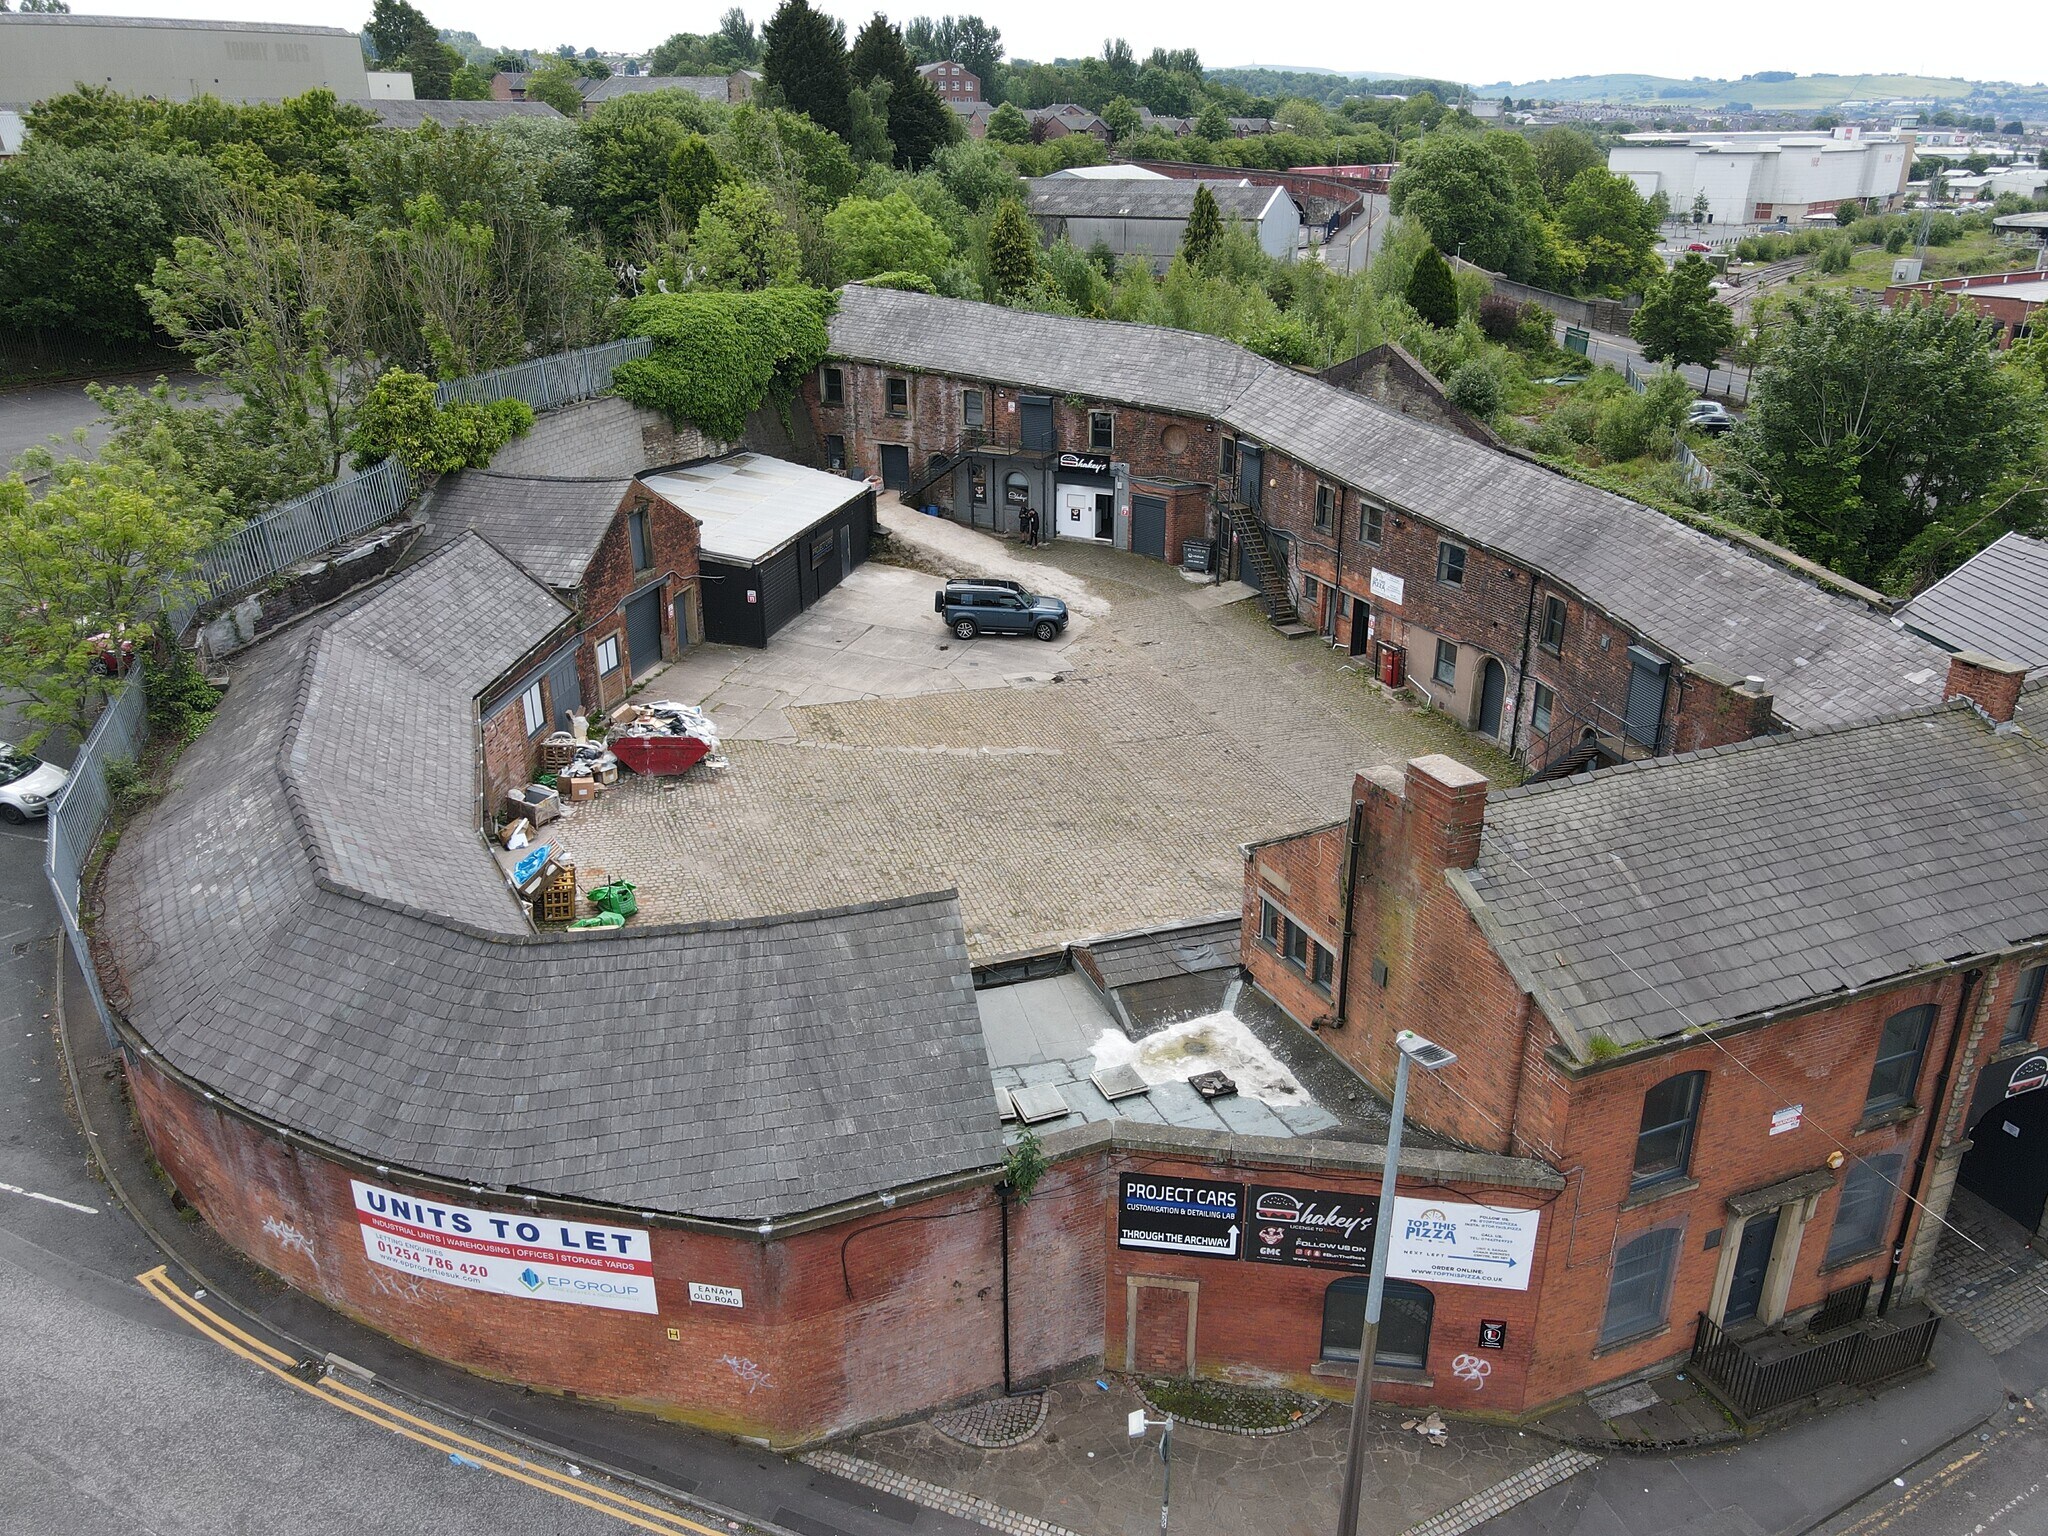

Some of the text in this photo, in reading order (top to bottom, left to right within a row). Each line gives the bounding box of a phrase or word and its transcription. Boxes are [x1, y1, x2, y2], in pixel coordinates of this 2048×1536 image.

[224, 41, 268, 61] TOMMY
[1060, 454, 1107, 473] Shakey's
[1127, 1183, 1236, 1207] PROJECT CARS
[1126, 1203, 1179, 1214] CUSTOMISATION
[1187, 1209, 1221, 1219] DETAILING
[1222, 1212, 1235, 1220] LAB
[1256, 1192, 1372, 1239] Shakey's
[366, 1190, 632, 1254] UNITS TO LET
[1408, 1219, 1457, 1231] TOP THIS
[372, 1217, 635, 1271] INDUSTRIAL UNITS WAREHOUSING OFFICES STORAGE YARDS
[375, 1232, 444, 1257] LETTING ENQUIRIES
[1122, 1229, 1229, 1247] THROUGH THE ARCHWAY
[1295, 1240, 1337, 1249] FOLLOW
[1405, 1226, 1457, 1245] PIZZA
[377, 1240, 488, 1278] 01254 786 420
[1260, 1247, 1281, 1255] GMC
[379, 1253, 481, 1284] www.eppropertiesuk.com
[1411, 1268, 1503, 1282] WWW.TOPTHISPIZZA.CO.UK
[547, 1276, 571, 1288] EP
[573, 1280, 639, 1295] GROUP
[698, 1285, 733, 1297] EANAM
[693, 1293, 739, 1305] OLD ROAD
[669, 1329, 679, 1339] H
